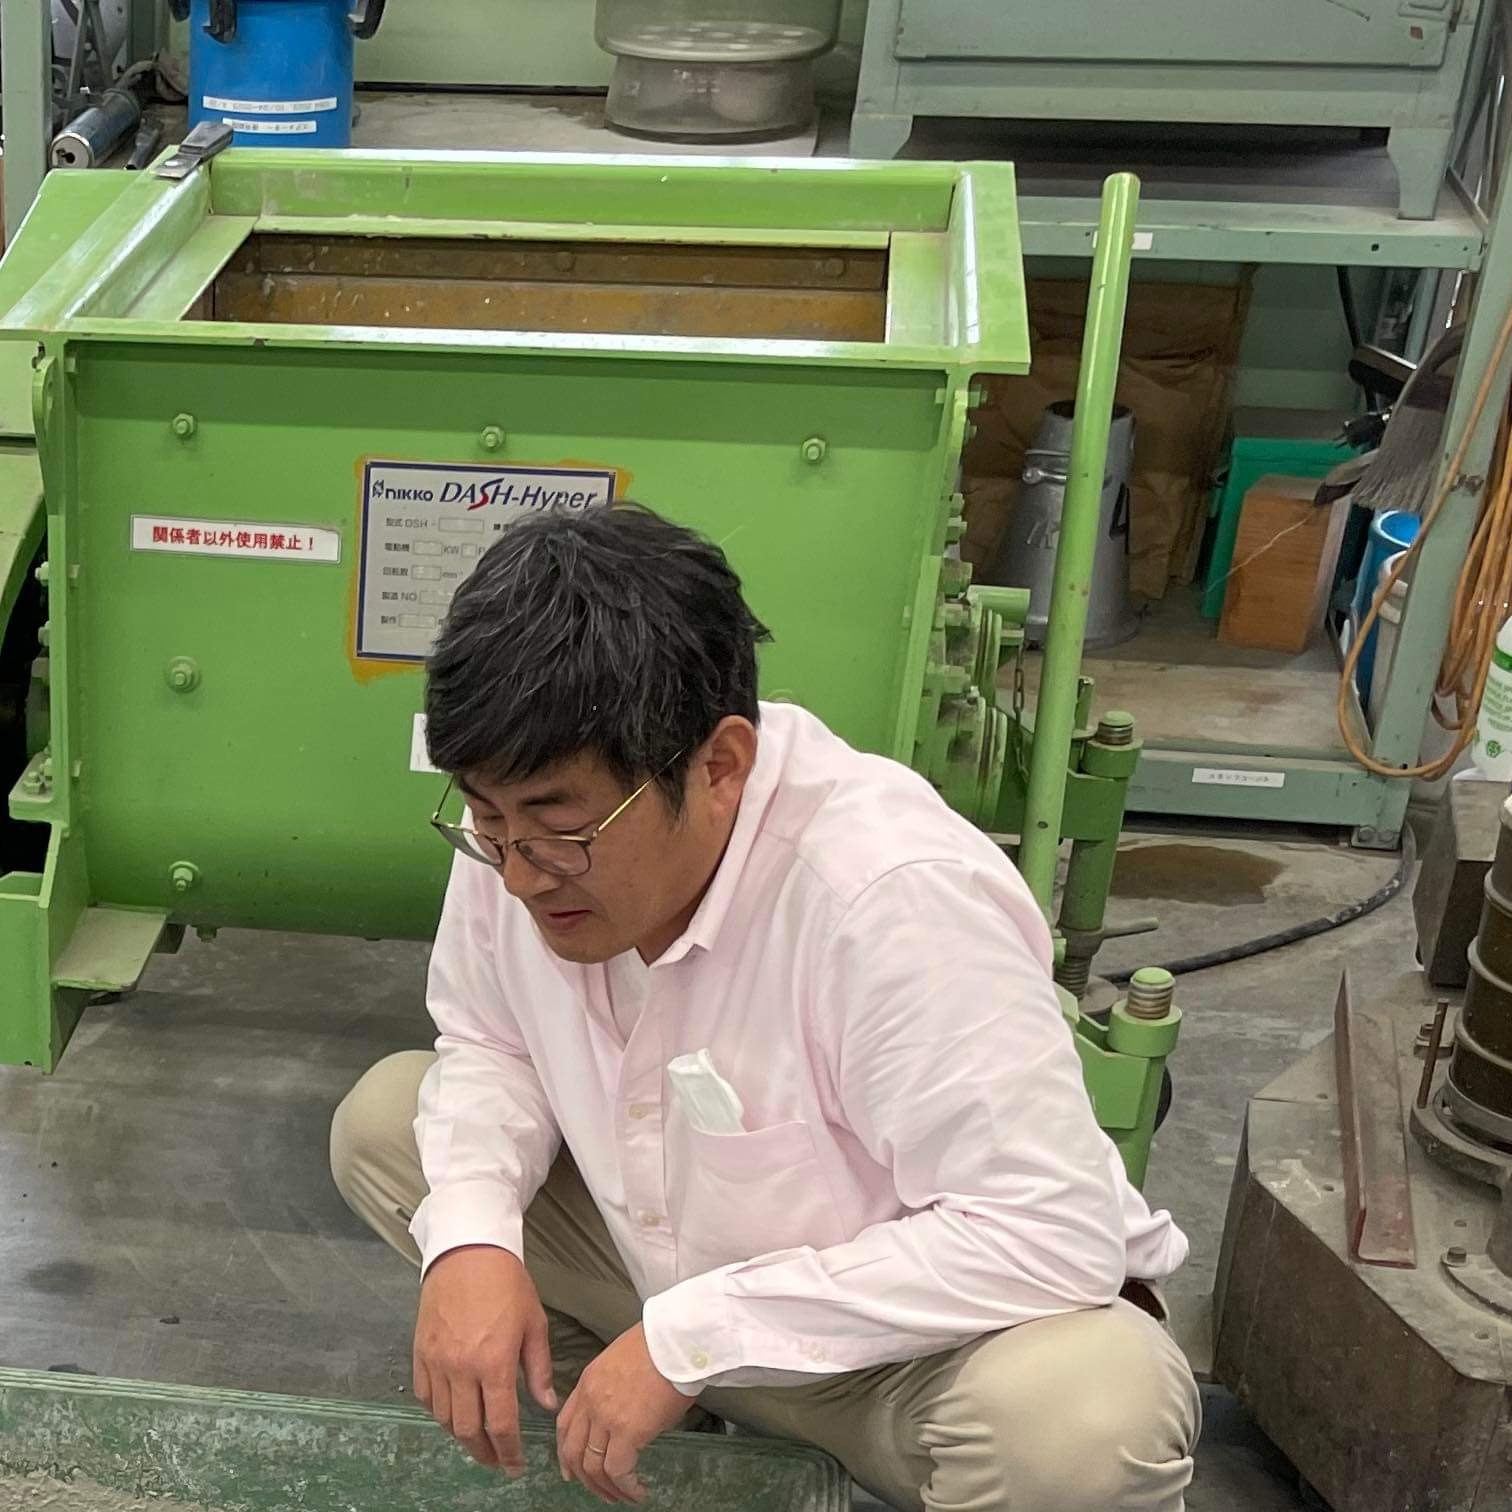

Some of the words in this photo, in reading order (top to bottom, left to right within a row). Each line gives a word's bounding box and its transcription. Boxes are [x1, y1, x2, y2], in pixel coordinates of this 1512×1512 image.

[439, 478, 598, 512] DASH-Hyper
[152, 526, 314, 551] 関係者以外使用禁止！
